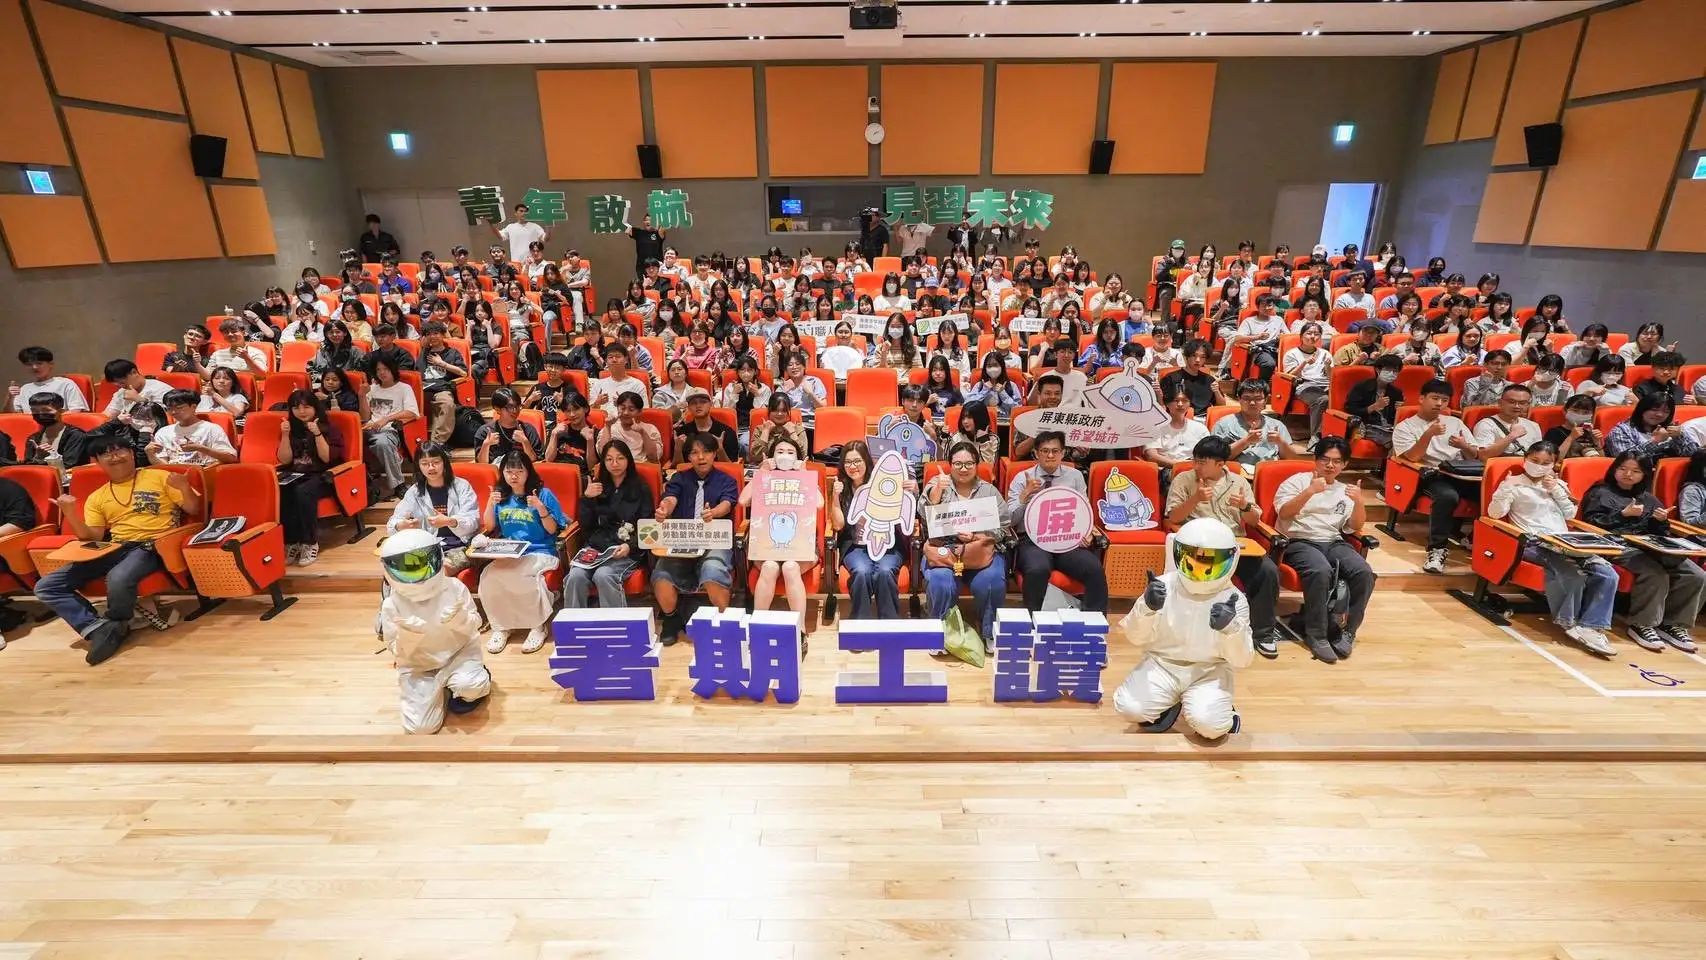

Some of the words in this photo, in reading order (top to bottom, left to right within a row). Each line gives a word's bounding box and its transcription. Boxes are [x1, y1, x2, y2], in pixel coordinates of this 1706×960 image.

[882, 185, 1054, 230] 見習未來
[1039, 411, 1105, 428] 屏東縣政府
[1069, 428, 1120, 444] 希望城市
[935, 509, 968, 521] 屏東縣政府
[1036, 496, 1077, 536] 屏
[661, 522, 704, 531] 屏東縣政府
[1036, 533, 1081, 544] PINGTUNG
[548, 607, 1110, 703] 暑期工讀
